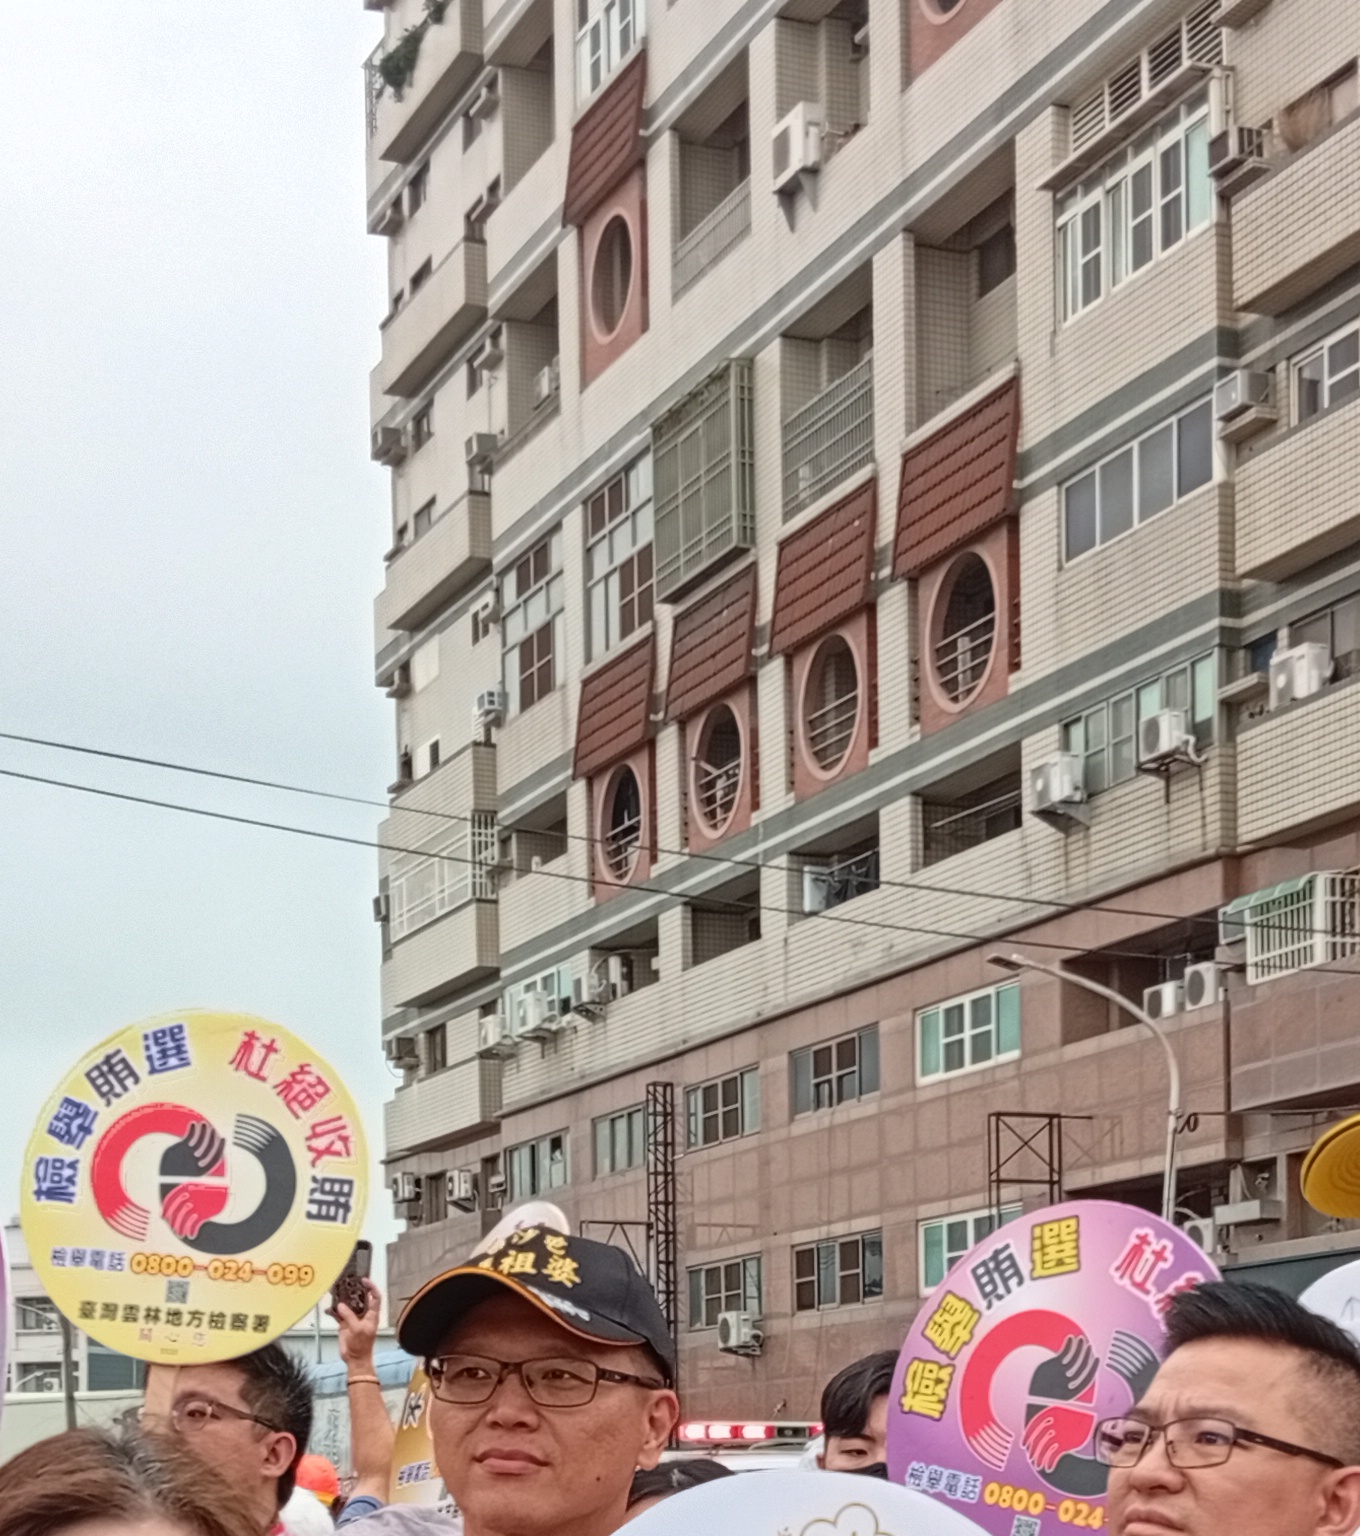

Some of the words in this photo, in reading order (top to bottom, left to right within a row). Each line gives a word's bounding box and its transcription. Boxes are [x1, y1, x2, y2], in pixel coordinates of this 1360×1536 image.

[34, 1024, 191, 1204] 檢舉賄選
[228, 1030, 355, 1224] 杜絕收賄
[130, 1252, 315, 1286] 0800-024-099
[900, 1215, 1081, 1420] 檢舉賄選
